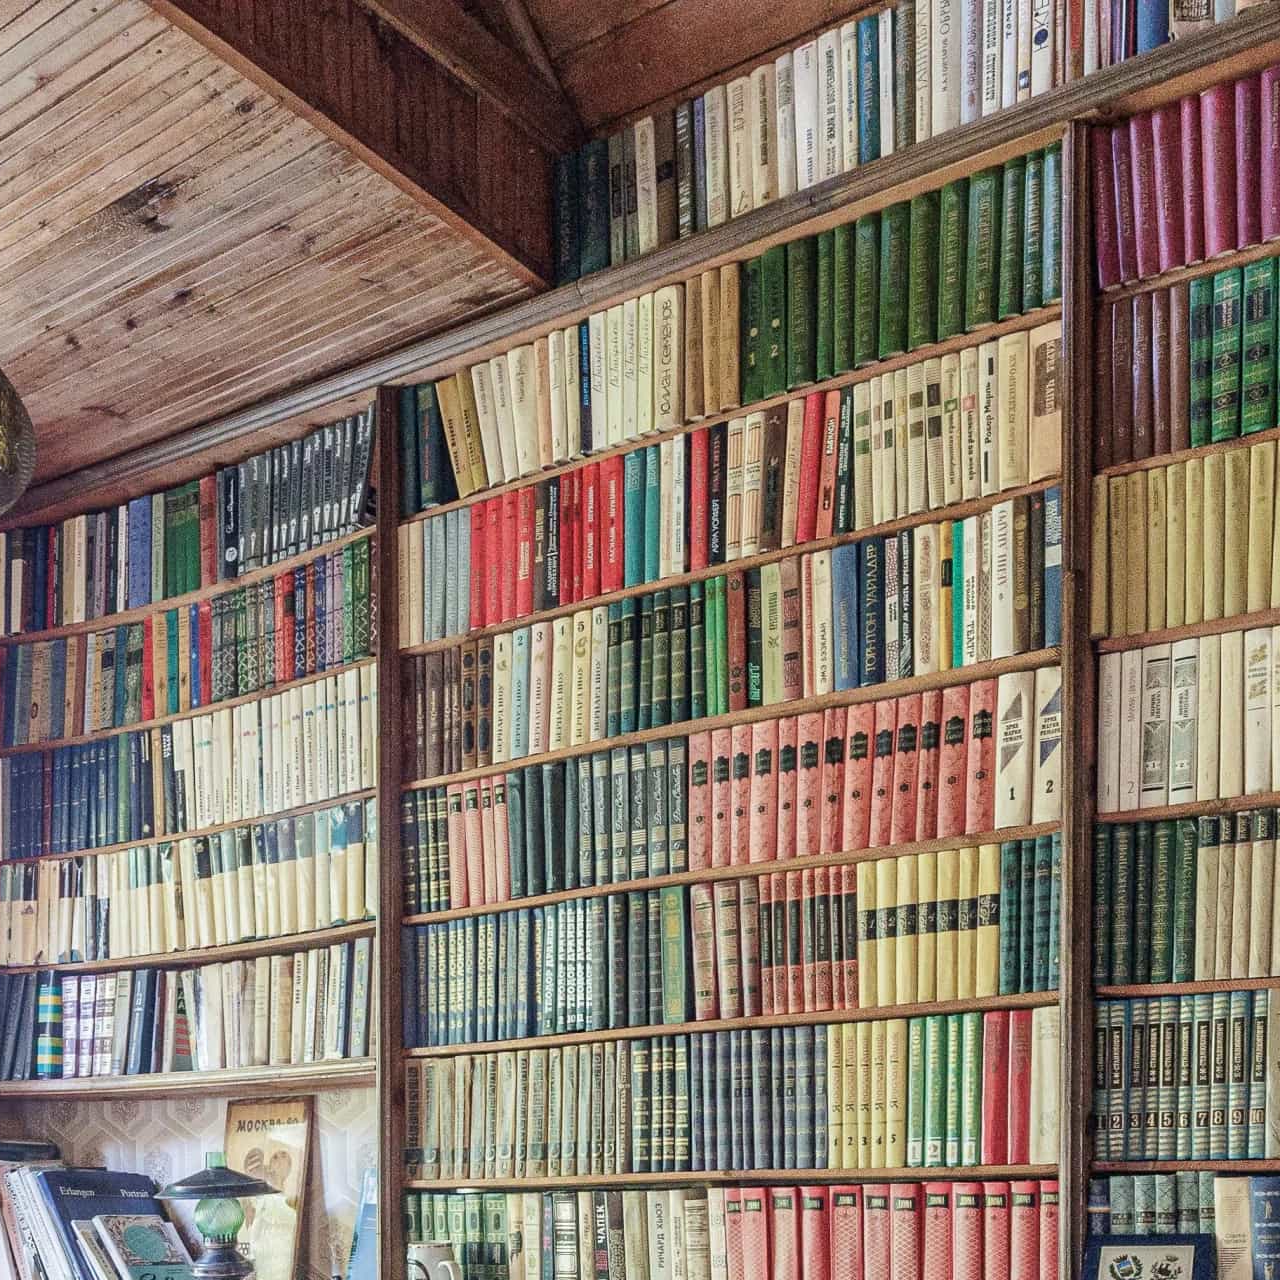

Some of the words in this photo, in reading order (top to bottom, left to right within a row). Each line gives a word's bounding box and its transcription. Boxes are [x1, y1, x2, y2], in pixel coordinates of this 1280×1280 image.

[769, 343, 779, 358] 2
[748, 351, 756, 367] 1
[865, 544, 877, 607] УАЙЛДЕР
[577, 621, 585, 633] 5
[535, 631, 544, 643] 3
[863, 611, 879, 675] ТОРНТОН
[1009, 787, 1016, 801] 1
[1044, 779, 1055, 795] 2
[1111, 1114, 1121, 1129] 2
[1130, 1113, 1140, 1128] 3
[1147, 1112, 1155, 1128] 4
[1162, 1111, 1172, 1127] 5
[1179, 1111, 1189, 1127] 6
[1197, 1111, 1207, 1127] 7
[1213, 1110, 1223, 1125] 8
[1233, 1109, 1243, 1124] 9
[1251, 1109, 1265, 1124] 10
[58, 1185, 96, 1199] Erlangen
[119, 1188, 151, 1199] Portrait
[595, 1204, 606, 1244] ЧАПЕК
[655, 1202, 665, 1230] ХЬЮЗ
[656, 1233, 665, 1269] РИЧАРД
